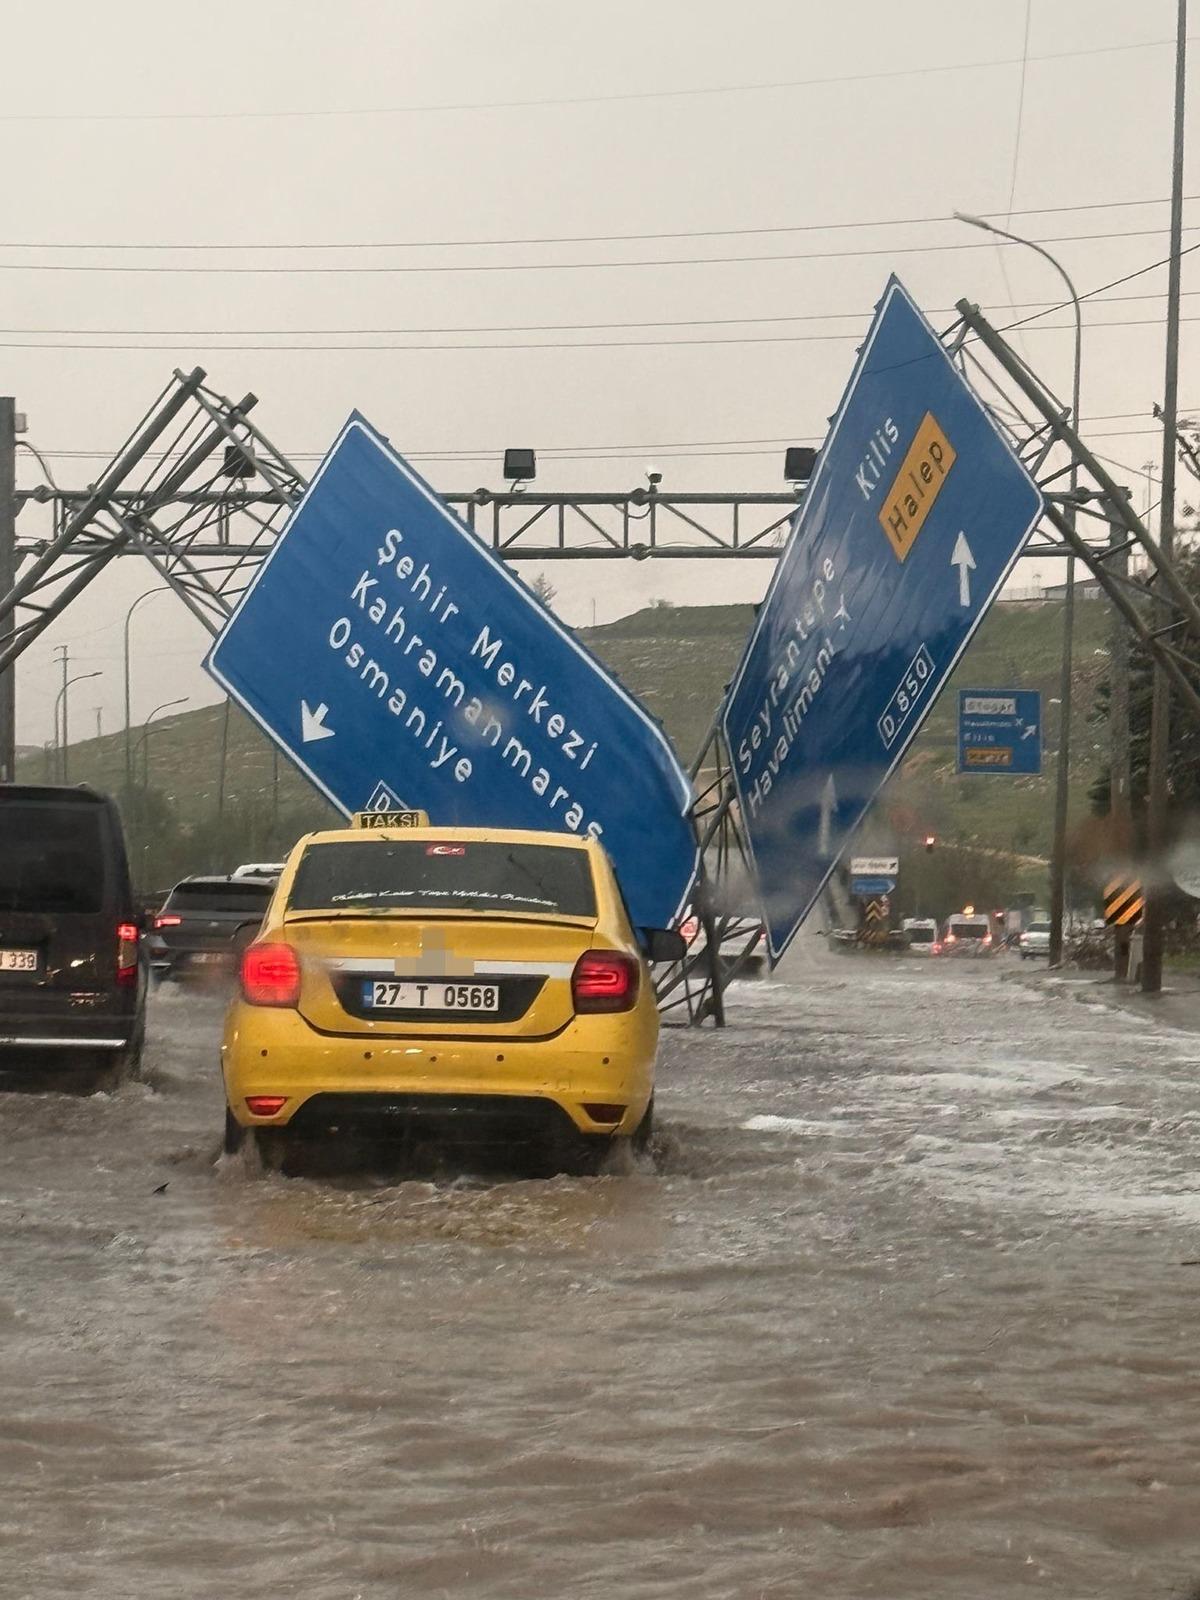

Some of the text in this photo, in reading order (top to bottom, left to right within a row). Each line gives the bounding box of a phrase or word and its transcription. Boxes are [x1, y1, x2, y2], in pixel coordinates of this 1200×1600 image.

[855, 416, 899, 500] Kilis
[888, 441, 945, 543] Halep
[328, 616, 474, 784] Osmaniye
[378, 529, 600, 770] Şehir Merkezi
[739, 557, 835, 775] Seyrantepe
[748, 637, 836, 818] Havalimanı
[375, 984, 496, 1008] 27 T 0568
